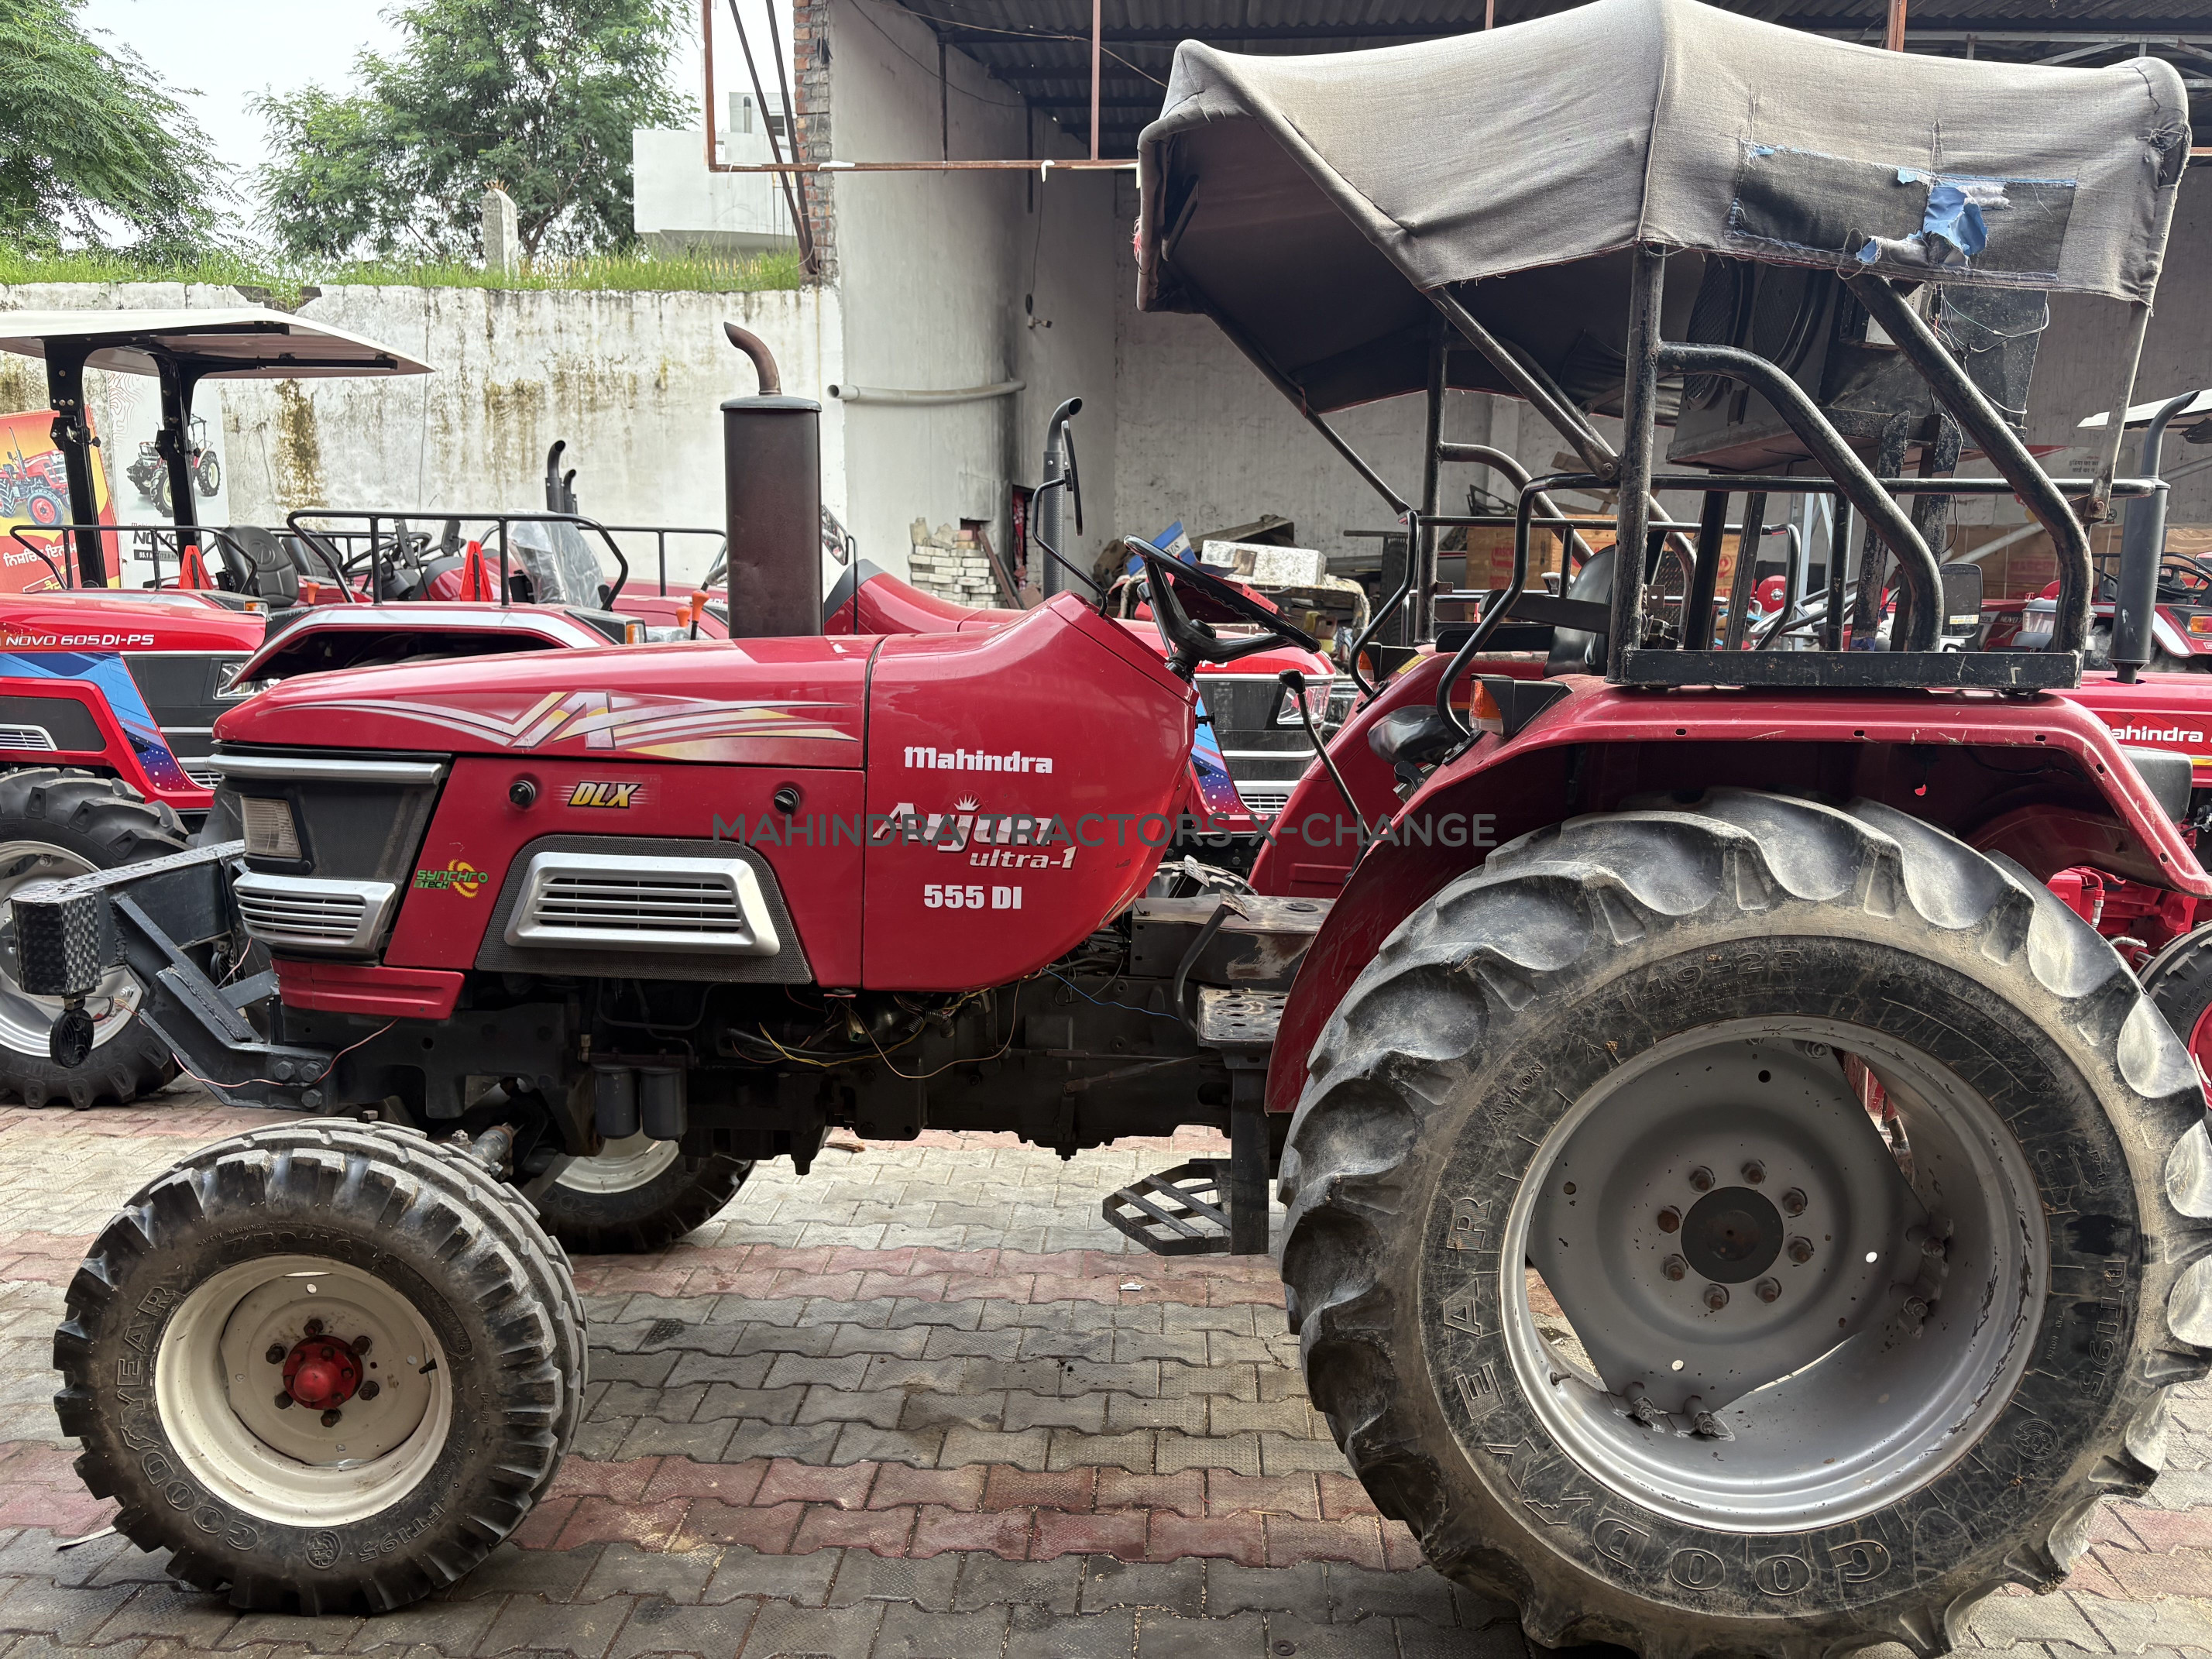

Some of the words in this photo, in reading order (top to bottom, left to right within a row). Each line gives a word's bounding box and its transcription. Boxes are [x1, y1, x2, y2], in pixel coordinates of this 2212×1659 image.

[5, 635, 57, 647] NOVO
[2108, 724, 2203, 743] ahindra
[903, 746, 1053, 774] Mahindra
[568, 781, 641, 809] DLX
[872, 801, 1056, 853] Arjun
[969, 846, 1078, 871] ultra-1
[924, 884, 984, 908] 555
[991, 885, 1022, 909] DI
[1493, 1063, 1545, 1124] NYLON
[2079, 1259, 2127, 1398] DT195
[1443, 1197, 1891, 1595] GOODYEAR
[116, 1286, 259, 1551] GOODYEAR
[359, 1502, 445, 1562] FT195
